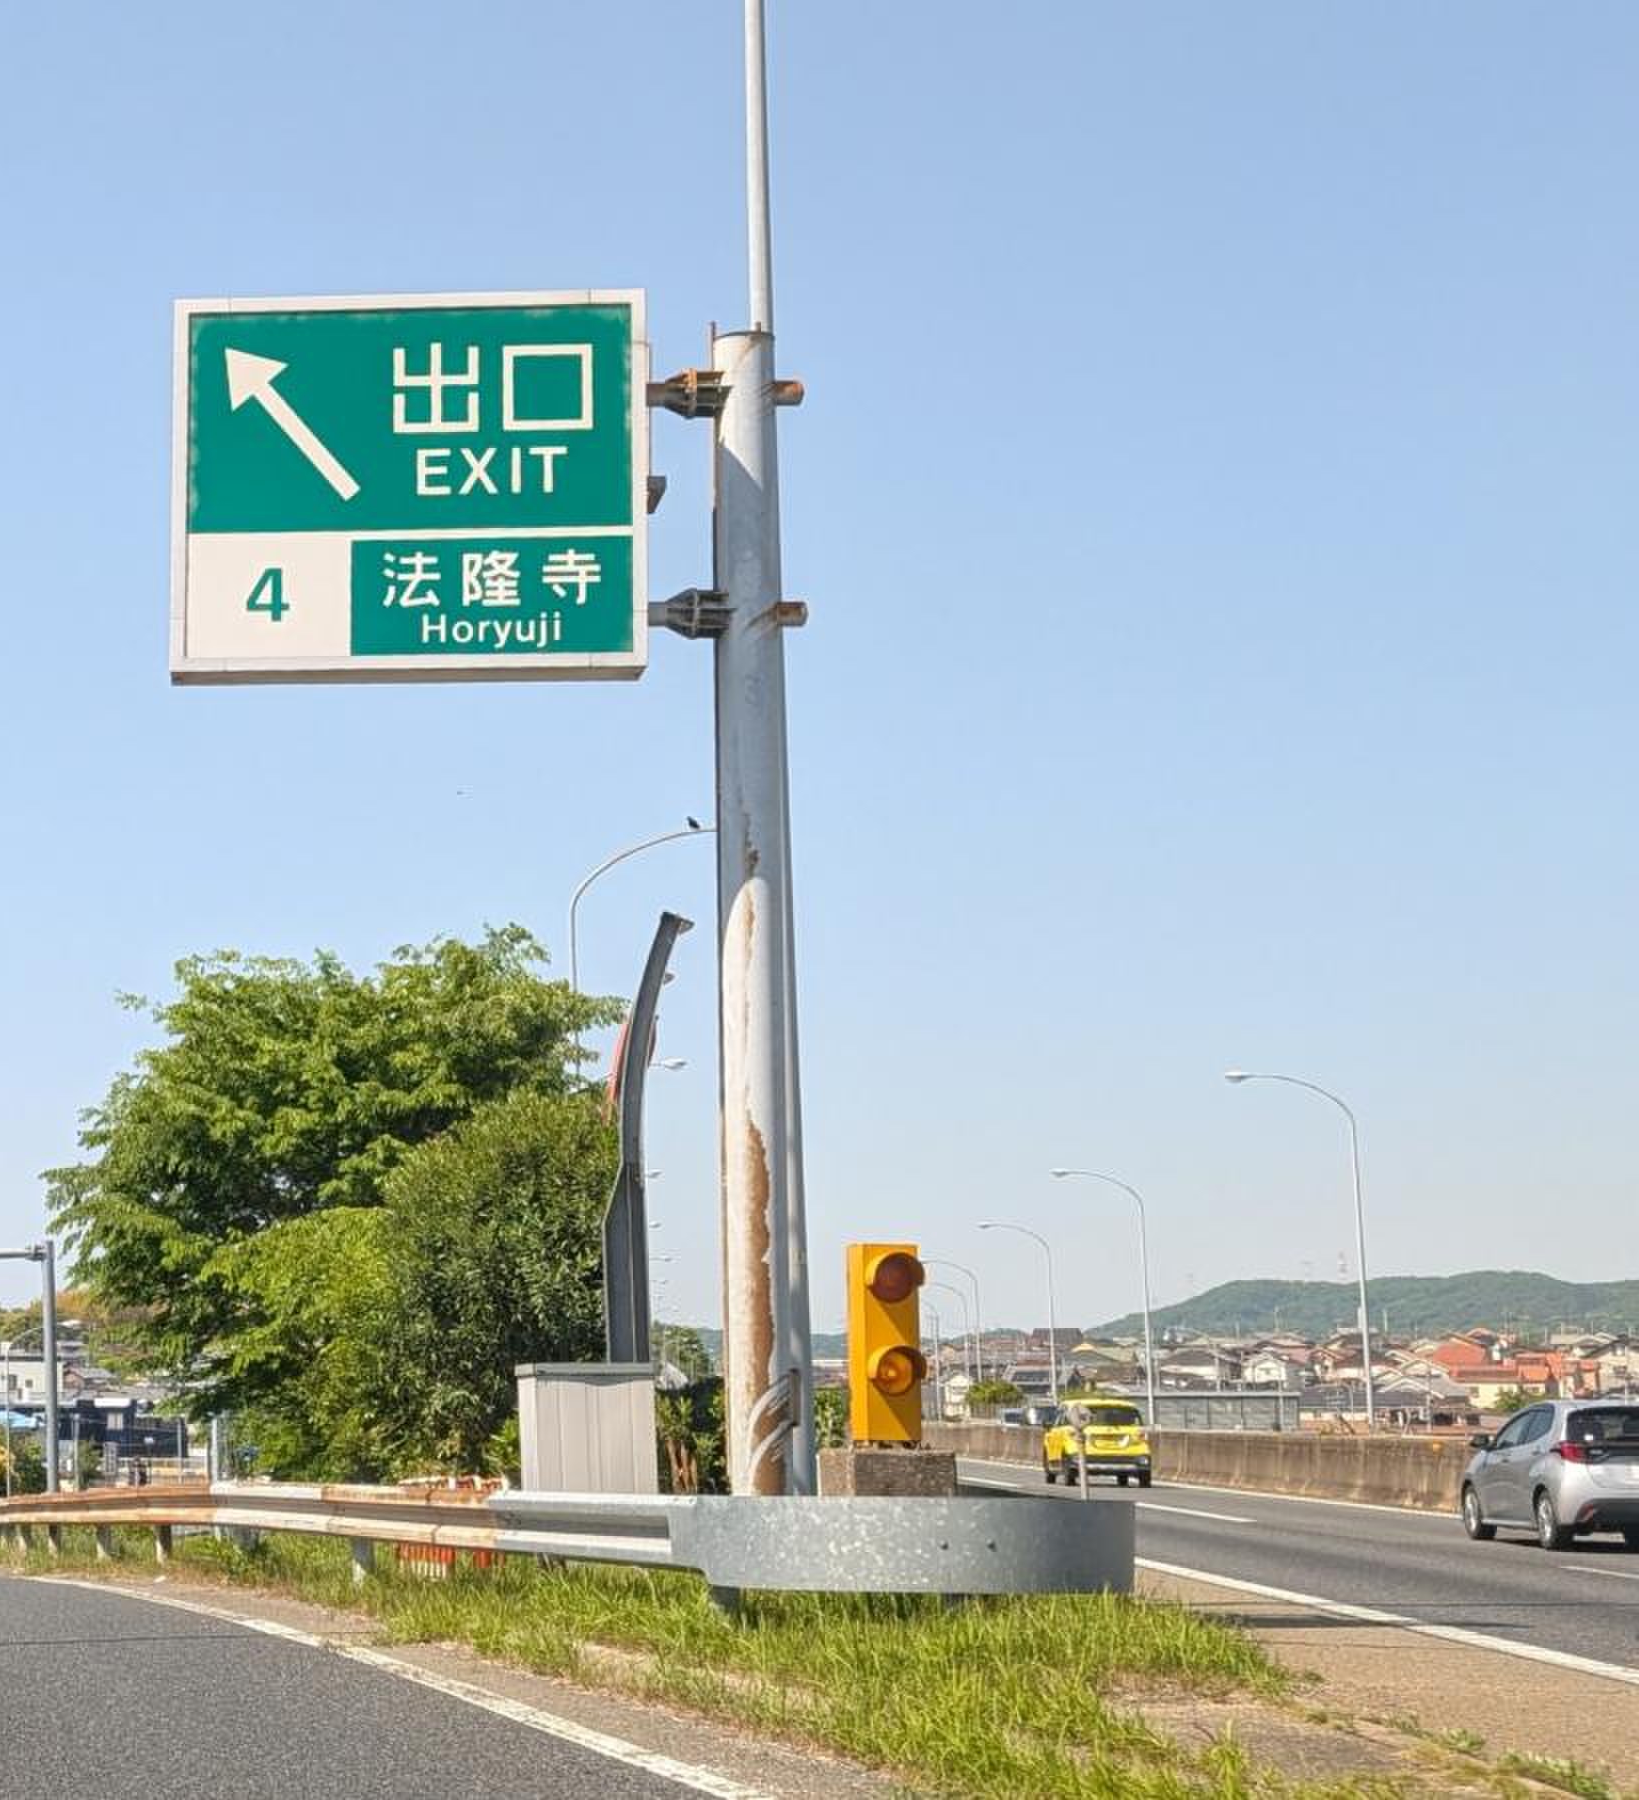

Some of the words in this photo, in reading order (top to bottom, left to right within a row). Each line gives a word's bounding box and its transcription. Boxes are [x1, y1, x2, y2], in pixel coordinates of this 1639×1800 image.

[392, 342, 594, 433] 出口
[415, 446, 567, 496] EXIT
[245, 567, 290, 622] 4
[382, 549, 602, 608] 法隆寺
[421, 613, 562, 649] Horyuji
